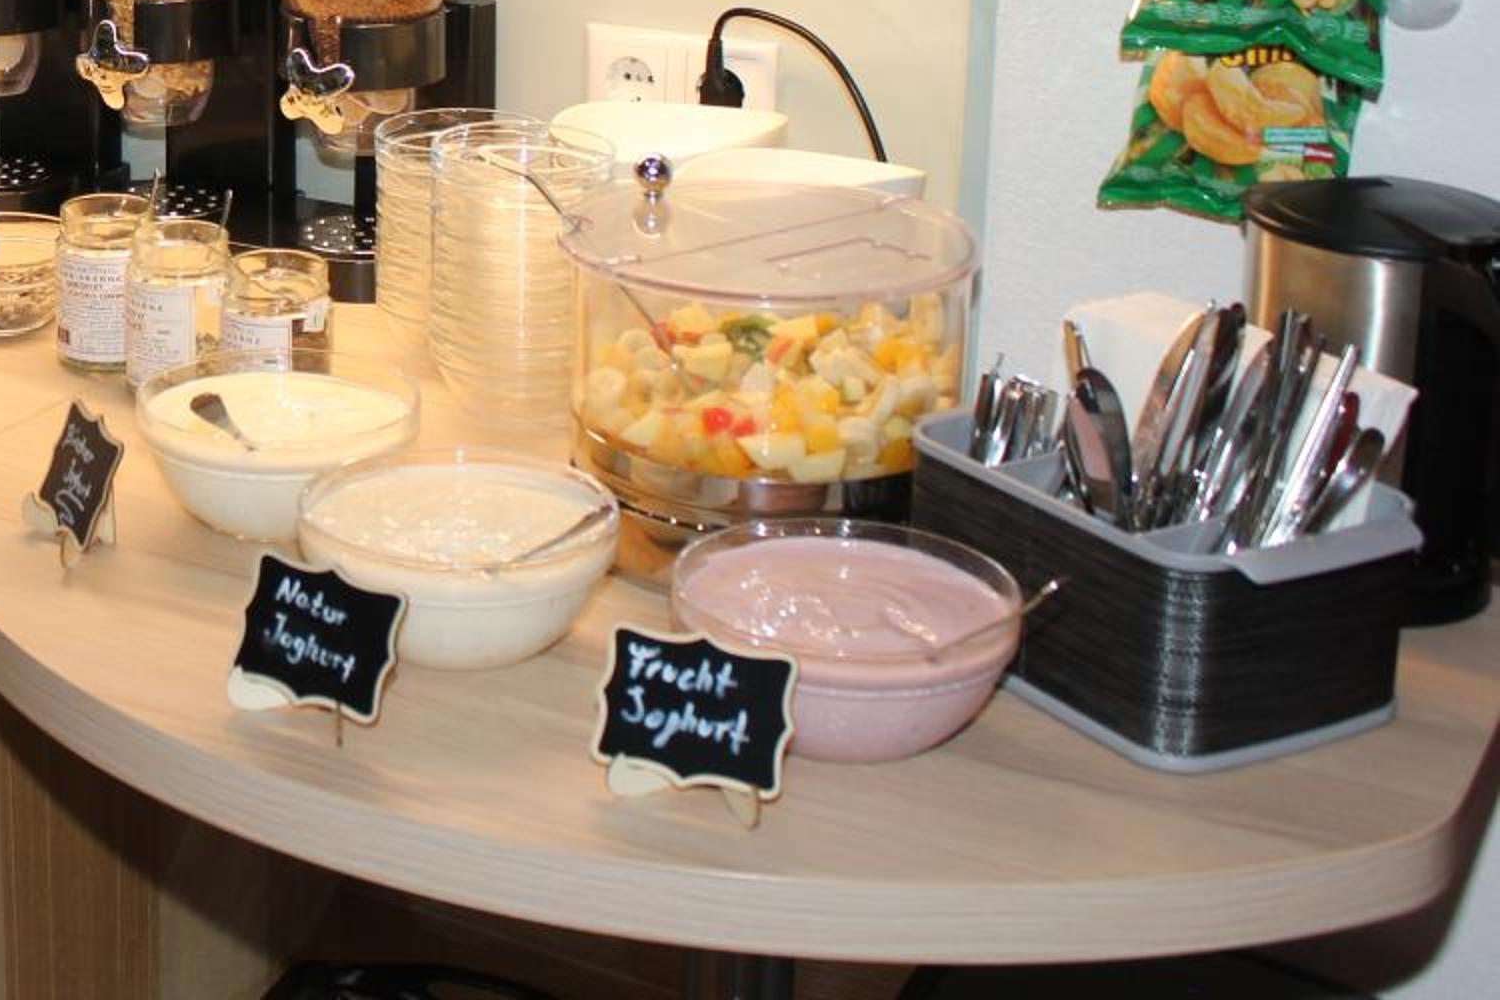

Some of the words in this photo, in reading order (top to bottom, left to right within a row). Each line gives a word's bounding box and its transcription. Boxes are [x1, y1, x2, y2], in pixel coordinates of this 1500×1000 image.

[275, 575, 349, 627] Natur
[262, 611, 357, 684] Joghurt
[627, 641, 738, 700] Frucht
[620, 684, 751, 757] Joghurt
